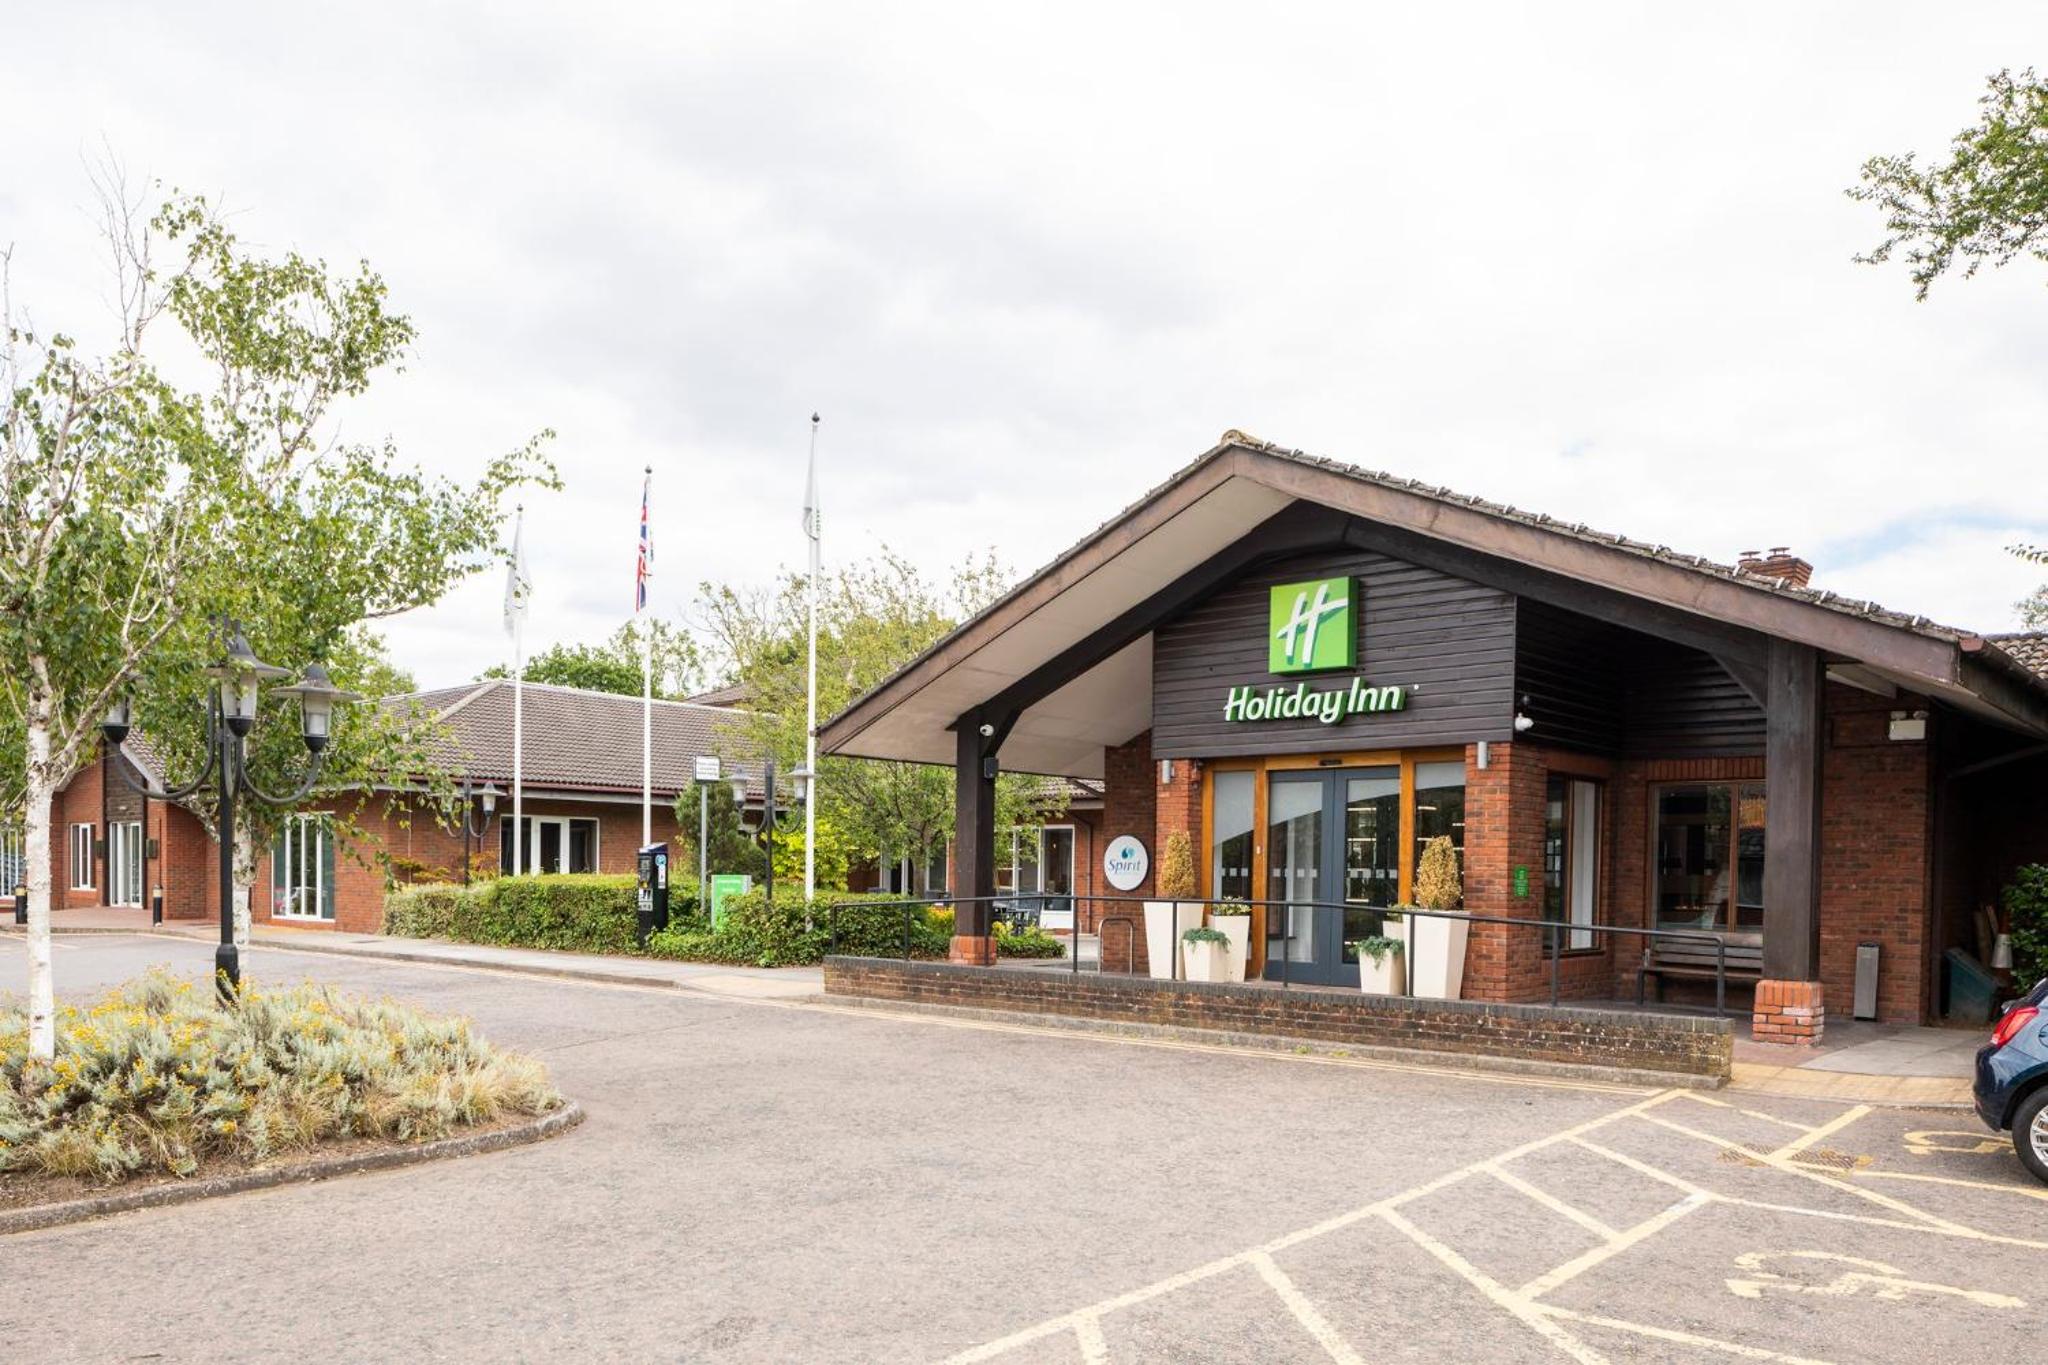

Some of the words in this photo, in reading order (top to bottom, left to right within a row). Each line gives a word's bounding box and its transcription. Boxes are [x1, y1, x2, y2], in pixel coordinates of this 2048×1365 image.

[1276, 583, 1348, 664] H
[1223, 683, 1343, 723] Holiday
[1347, 676, 1402, 712] Inn
[1108, 860, 1141, 874] Spirit
